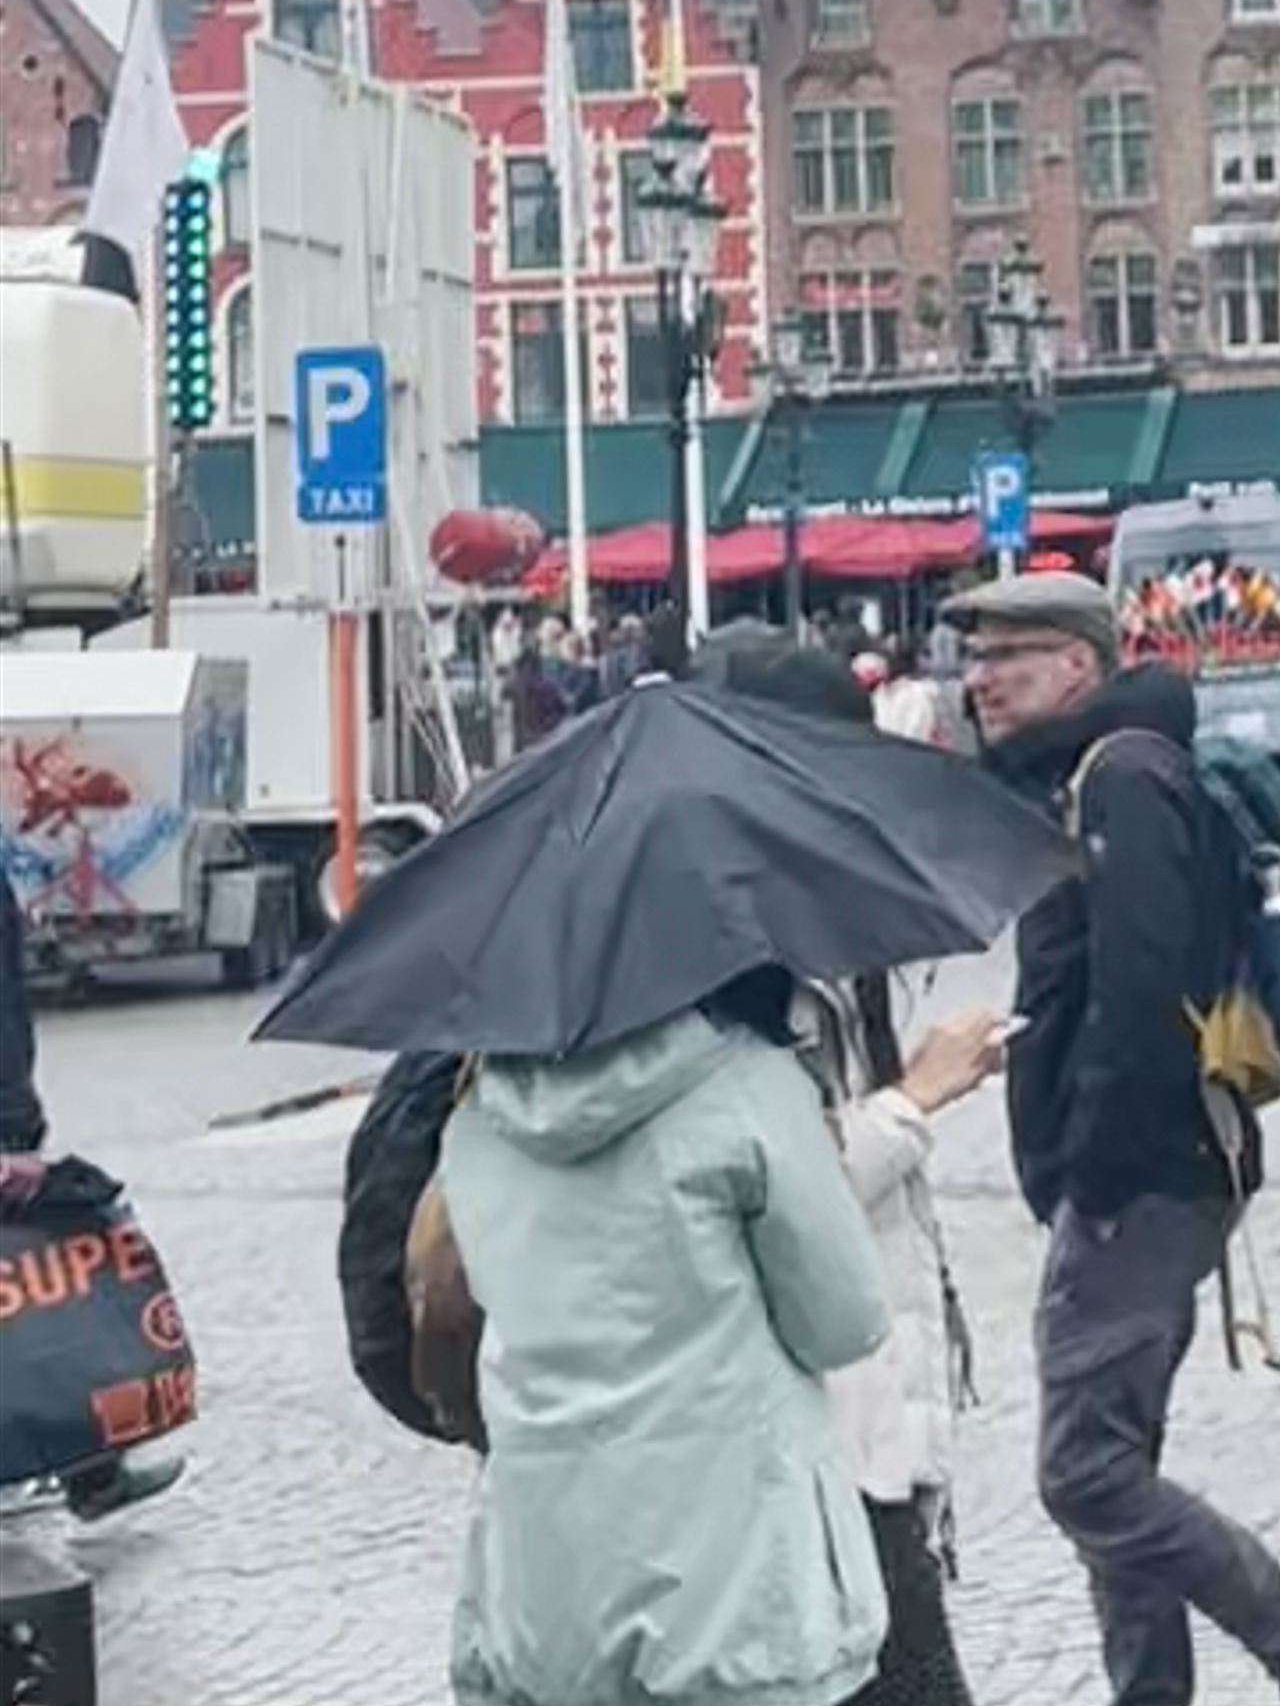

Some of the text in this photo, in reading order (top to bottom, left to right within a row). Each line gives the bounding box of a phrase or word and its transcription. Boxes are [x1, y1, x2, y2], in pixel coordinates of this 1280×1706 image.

[308, 367, 370, 459] P
[312, 488, 373, 514] TAXI
[987, 466, 1019, 516] P
